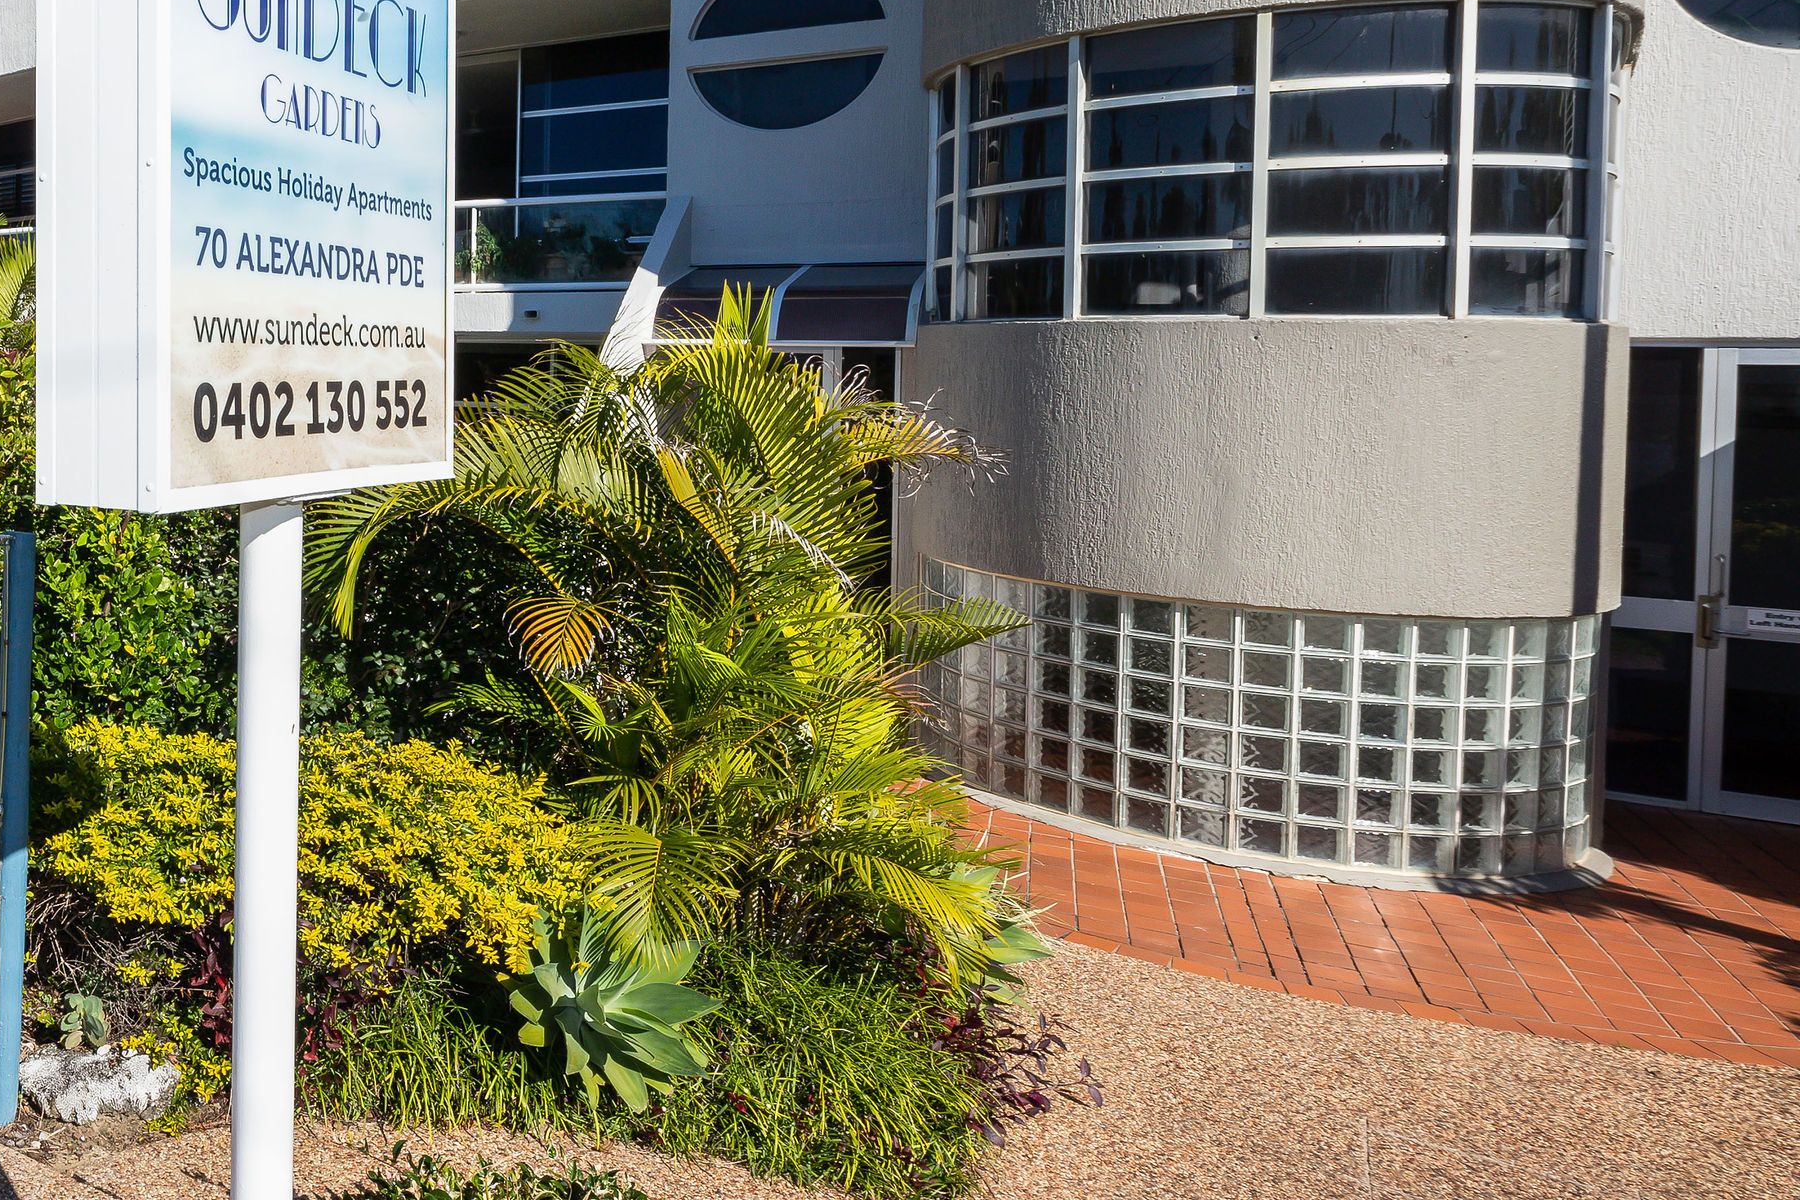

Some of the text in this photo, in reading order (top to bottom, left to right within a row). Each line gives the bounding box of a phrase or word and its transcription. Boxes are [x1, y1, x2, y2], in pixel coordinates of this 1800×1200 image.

[260, 73, 381, 149] GARDENS
[183, 146, 433, 221] Spacious Holiday Apartments
[195, 225, 425, 288] 70 ALEXANDRA PDE
[193, 312, 426, 349] www.sundeck.com.au
[193, 379, 428, 443] 0402 130 552
